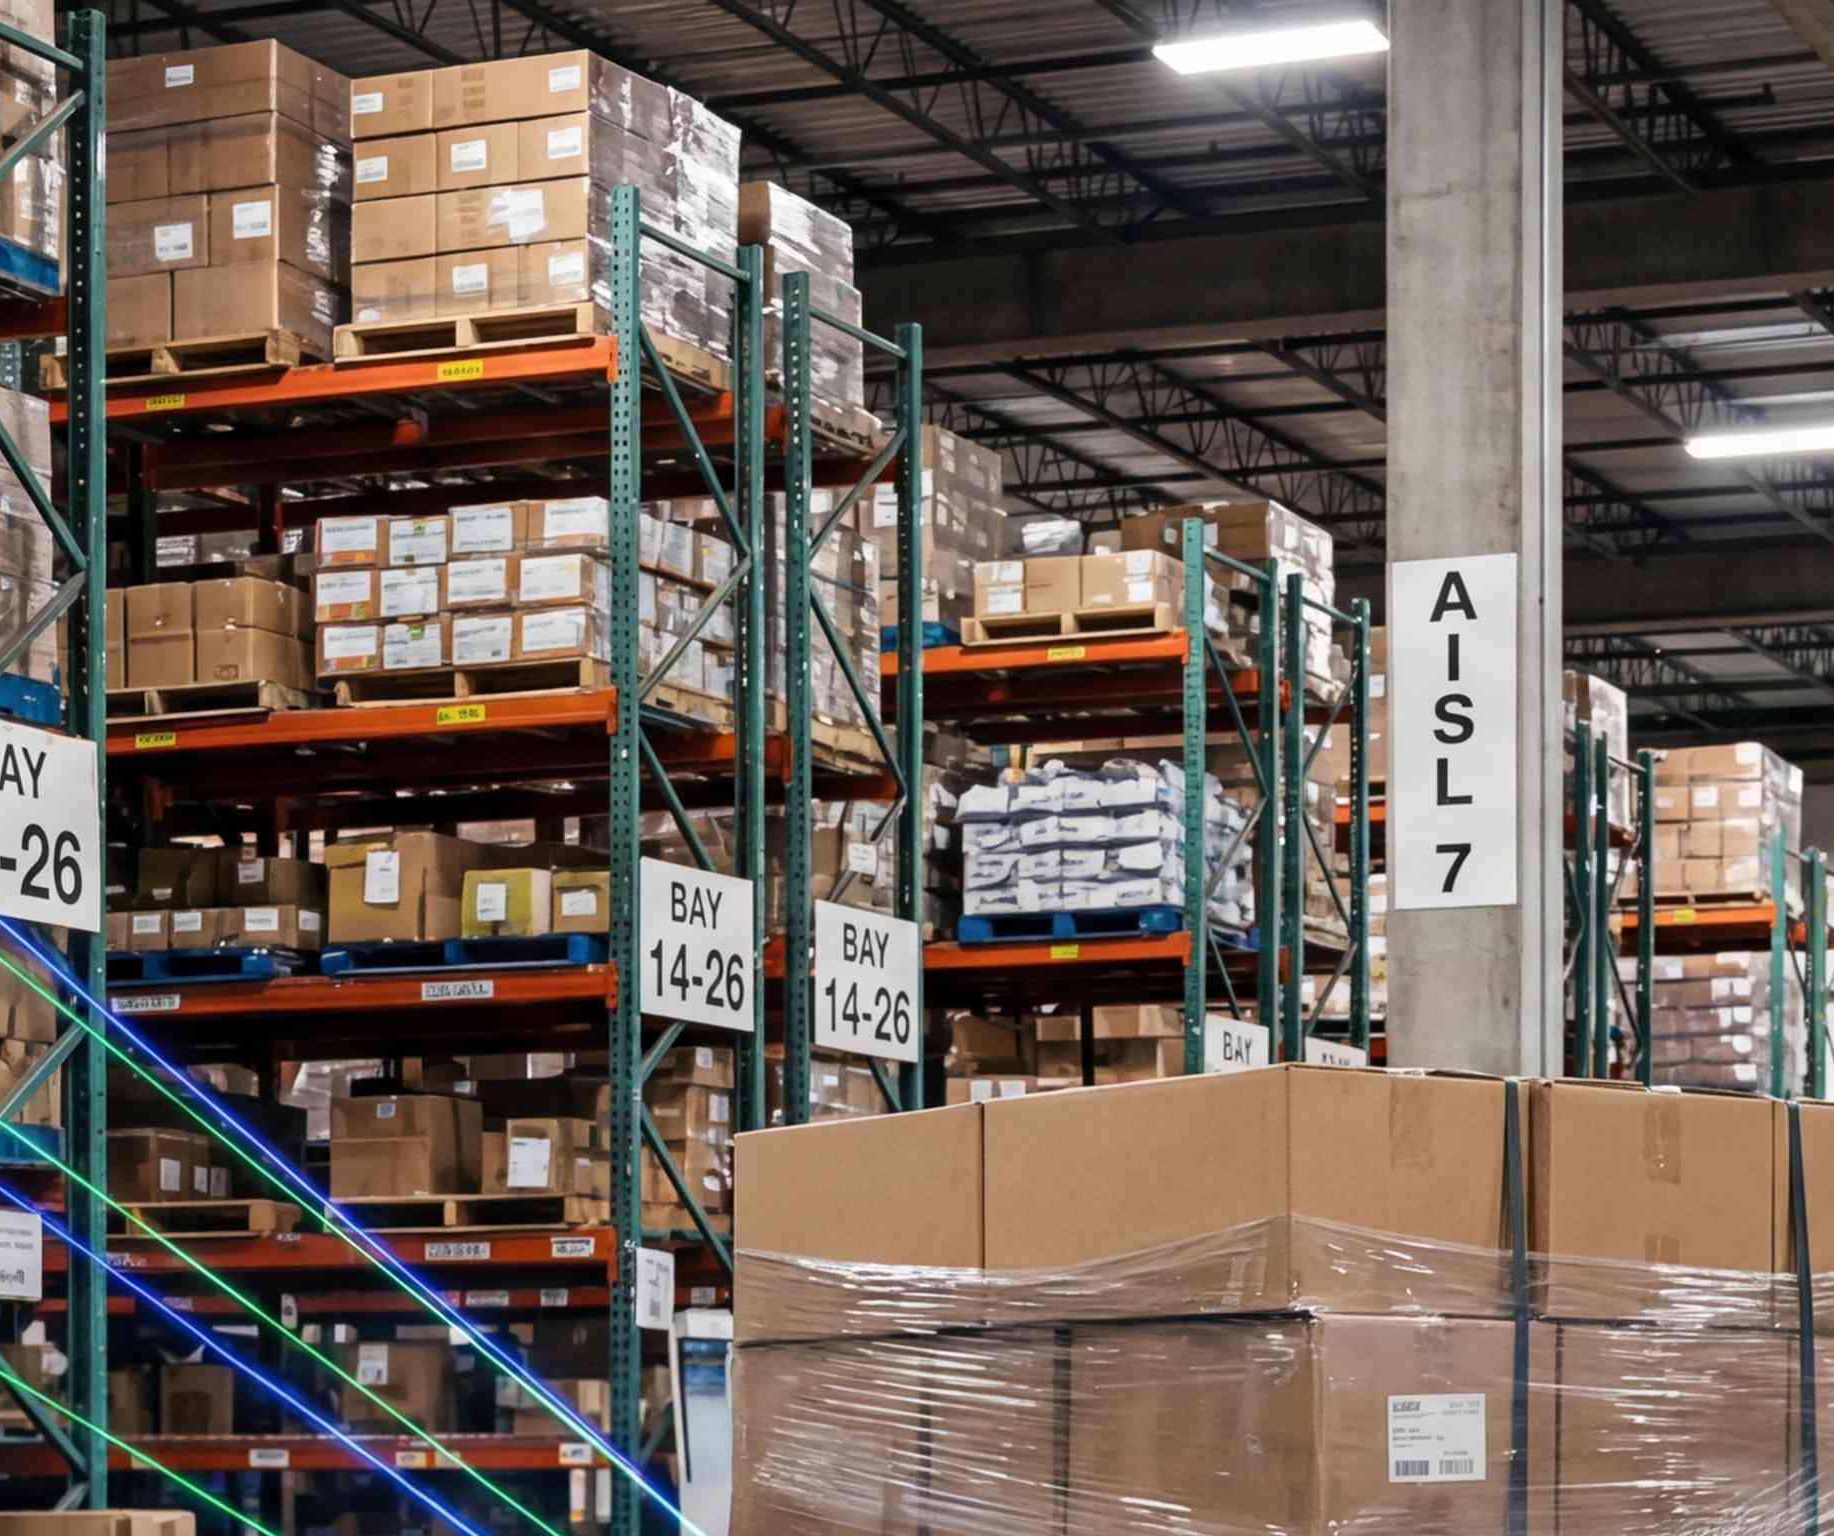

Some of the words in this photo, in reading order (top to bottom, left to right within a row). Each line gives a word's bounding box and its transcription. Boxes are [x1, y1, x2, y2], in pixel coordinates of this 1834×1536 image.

[1429, 571, 1478, 806] AISL
[1435, 842, 1472, 893] 7
[671, 881, 723, 930] BAY
[843, 922, 890, 969] BAY
[650, 939, 745, 1012] 14-26
[825, 978, 910, 1045] 14-26
[1223, 1031, 1253, 1064] BAY
